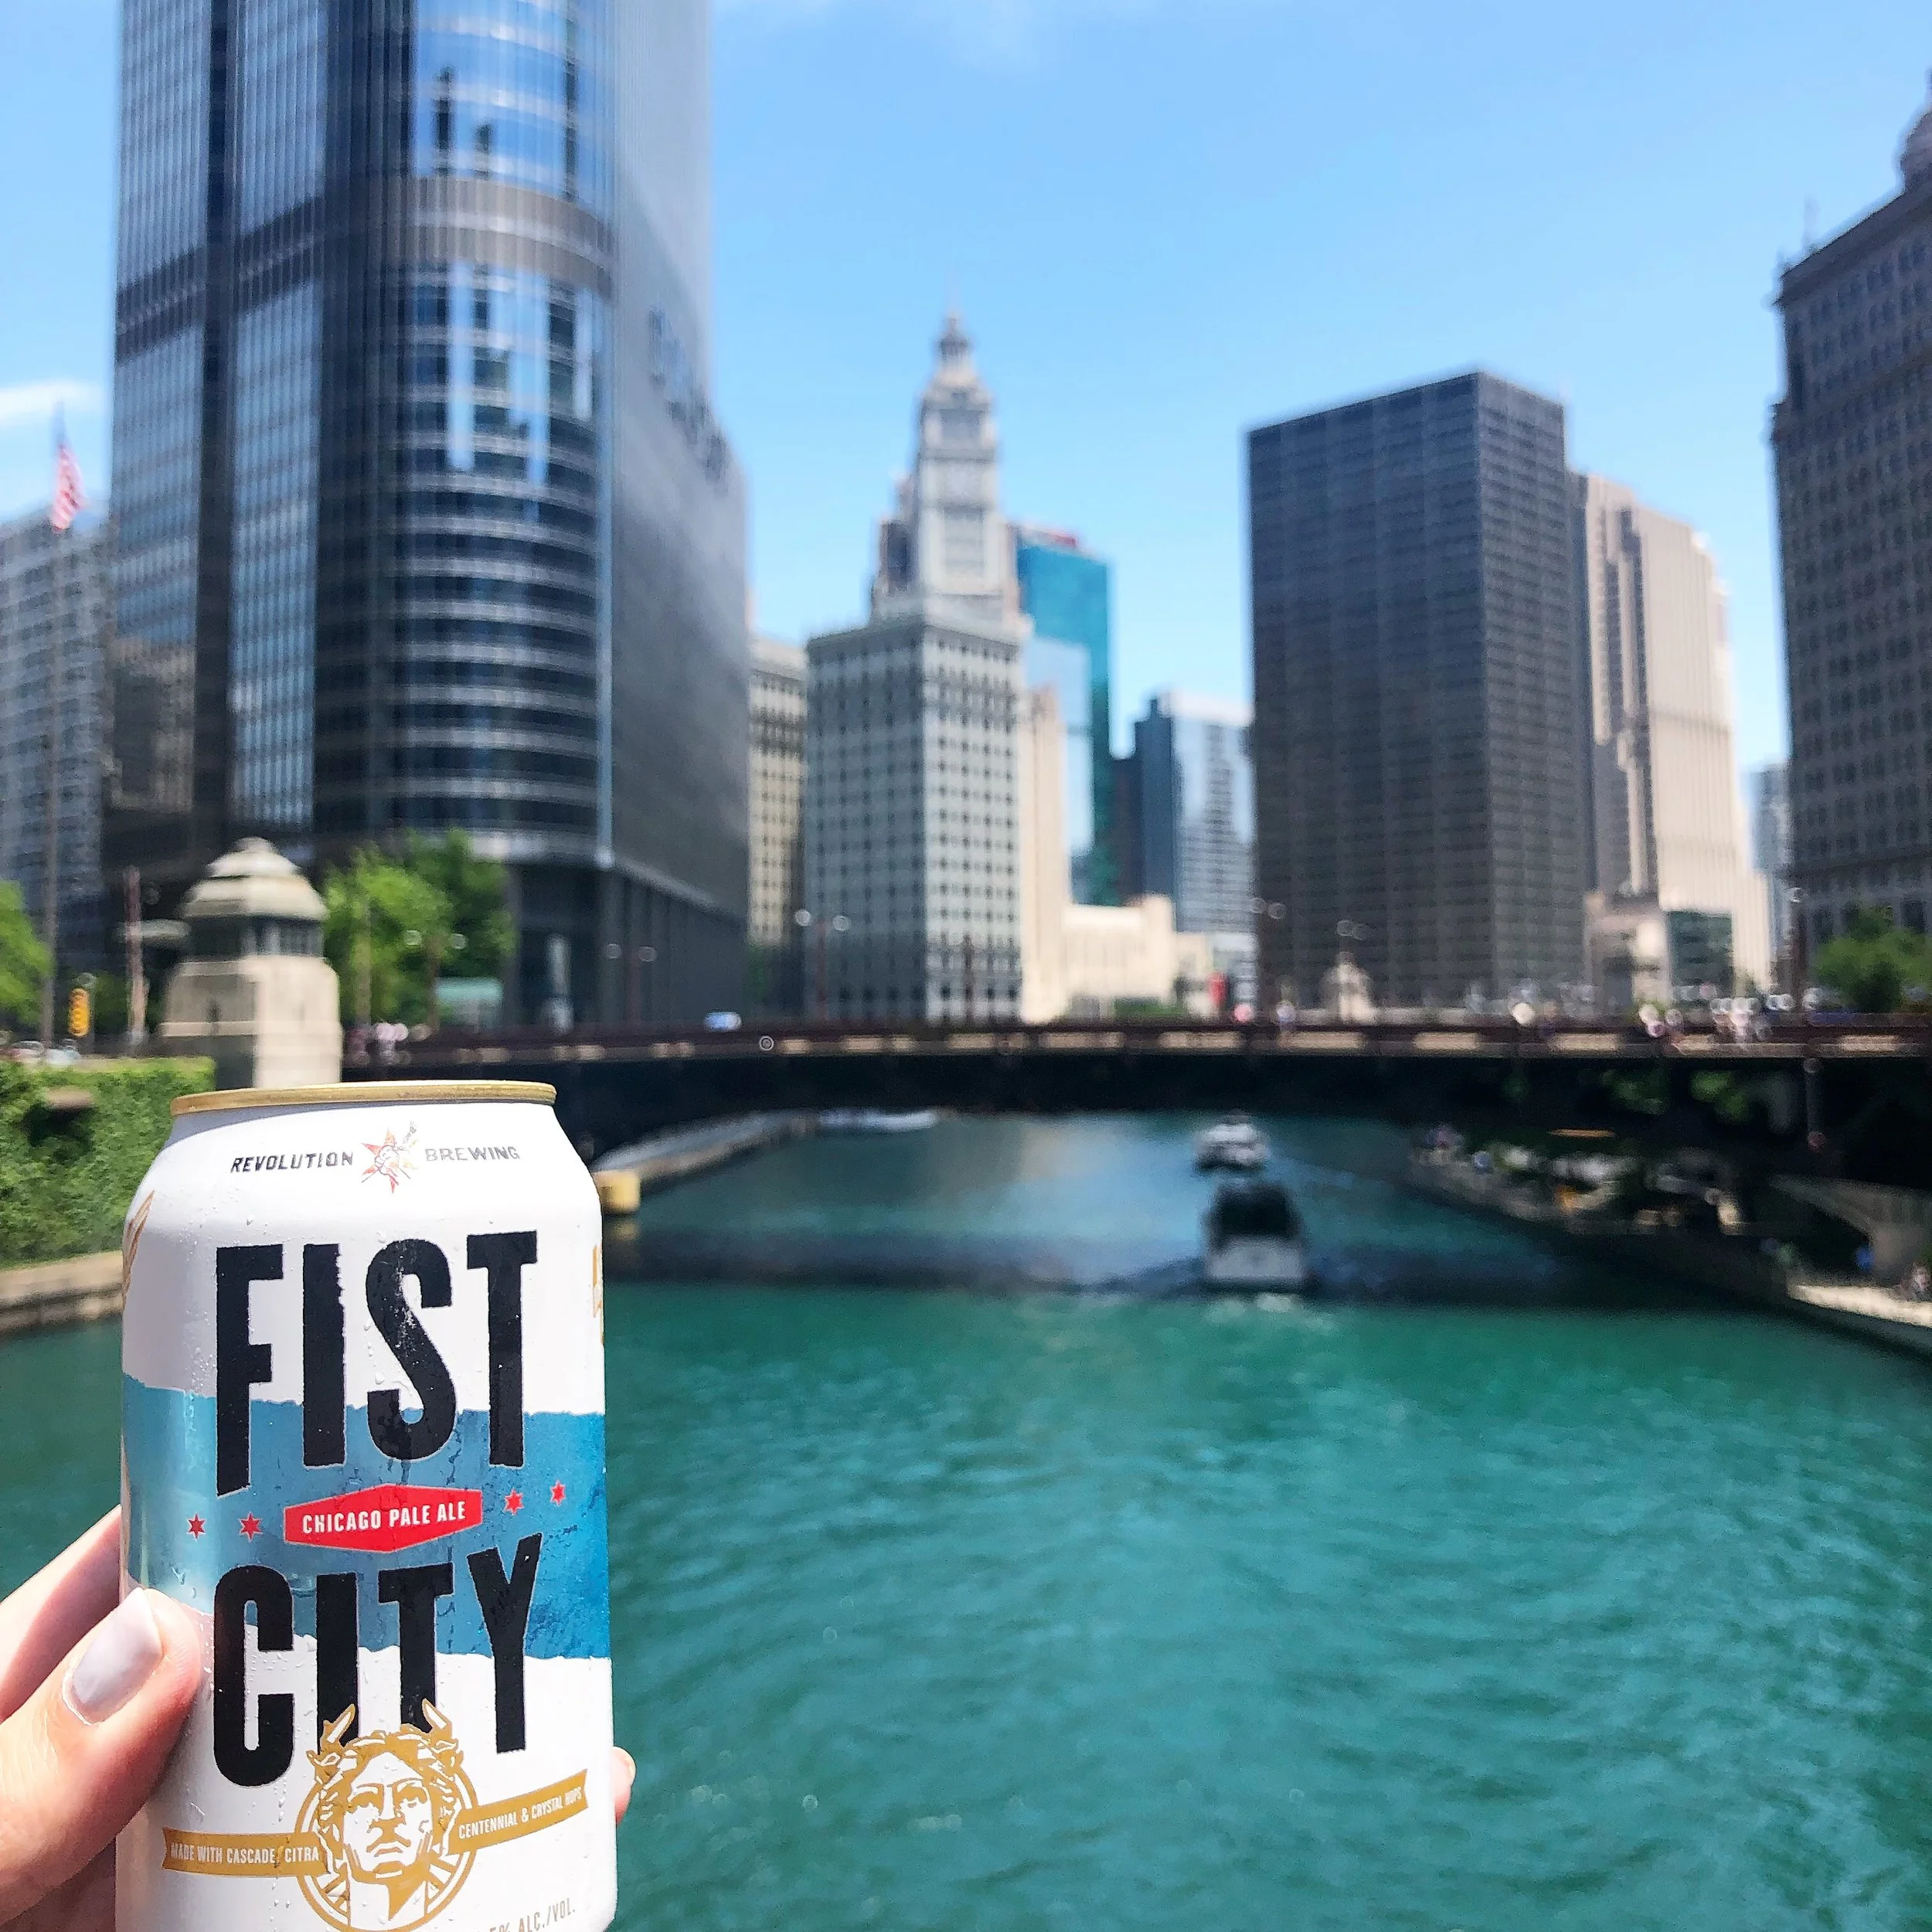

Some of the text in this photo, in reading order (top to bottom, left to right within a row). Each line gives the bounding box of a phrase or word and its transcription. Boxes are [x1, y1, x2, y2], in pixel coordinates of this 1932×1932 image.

[230, 1146, 521, 1173] REVOLUTION BREWING
[216, 1230, 538, 1497] FIST
[303, 1501, 466, 1534] CHICAGO PALE ALE
[213, 1532, 543, 1787] CITY
[458, 1811, 519, 1839] CENTENNIAL
[521, 1807, 529, 1823] &
[531, 1795, 563, 1819] CRYSTAL
[170, 1842, 195, 1861] MADE
[197, 1845, 223, 1864] WITH
[284, 1846, 319, 1863] CITRA
